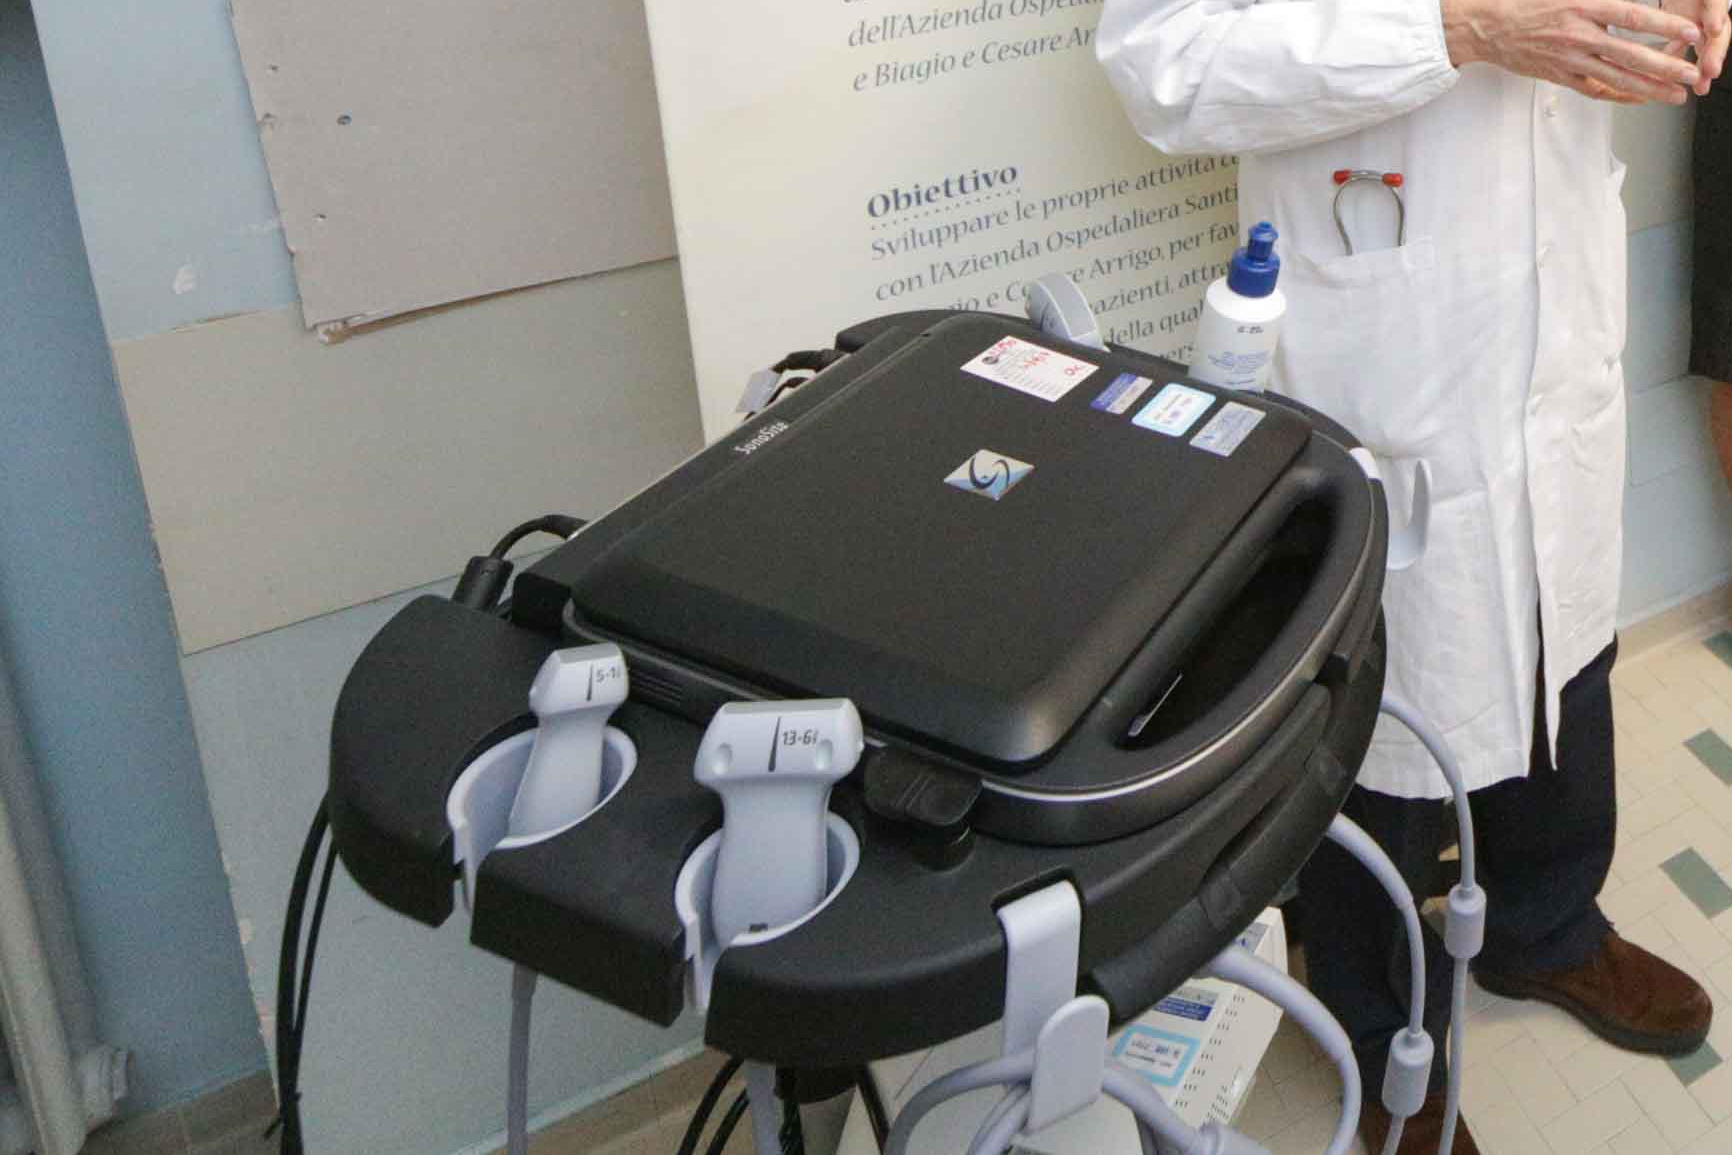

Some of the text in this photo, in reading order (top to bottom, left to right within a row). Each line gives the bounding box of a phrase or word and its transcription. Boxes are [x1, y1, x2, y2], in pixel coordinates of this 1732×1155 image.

[852, 72, 868, 92] e
[874, 53, 956, 88] Biagio
[961, 50, 977, 70] e
[981, 31, 1065, 65] Cesare
[867, 166, 1018, 218] Obiettivo
[871, 209, 1009, 261] Sviluppare
[1015, 199, 1036, 222] le
[1042, 177, 1129, 220] proprie
[875, 272, 925, 302] con
[930, 238, 1041, 286] l'Azienda
[1045, 202, 1180, 254] Ospedaliera
[1168, 231, 1205, 260] per
[1089, 275, 1175, 316] azienti,
[734, 421, 789, 455] SonoSite
